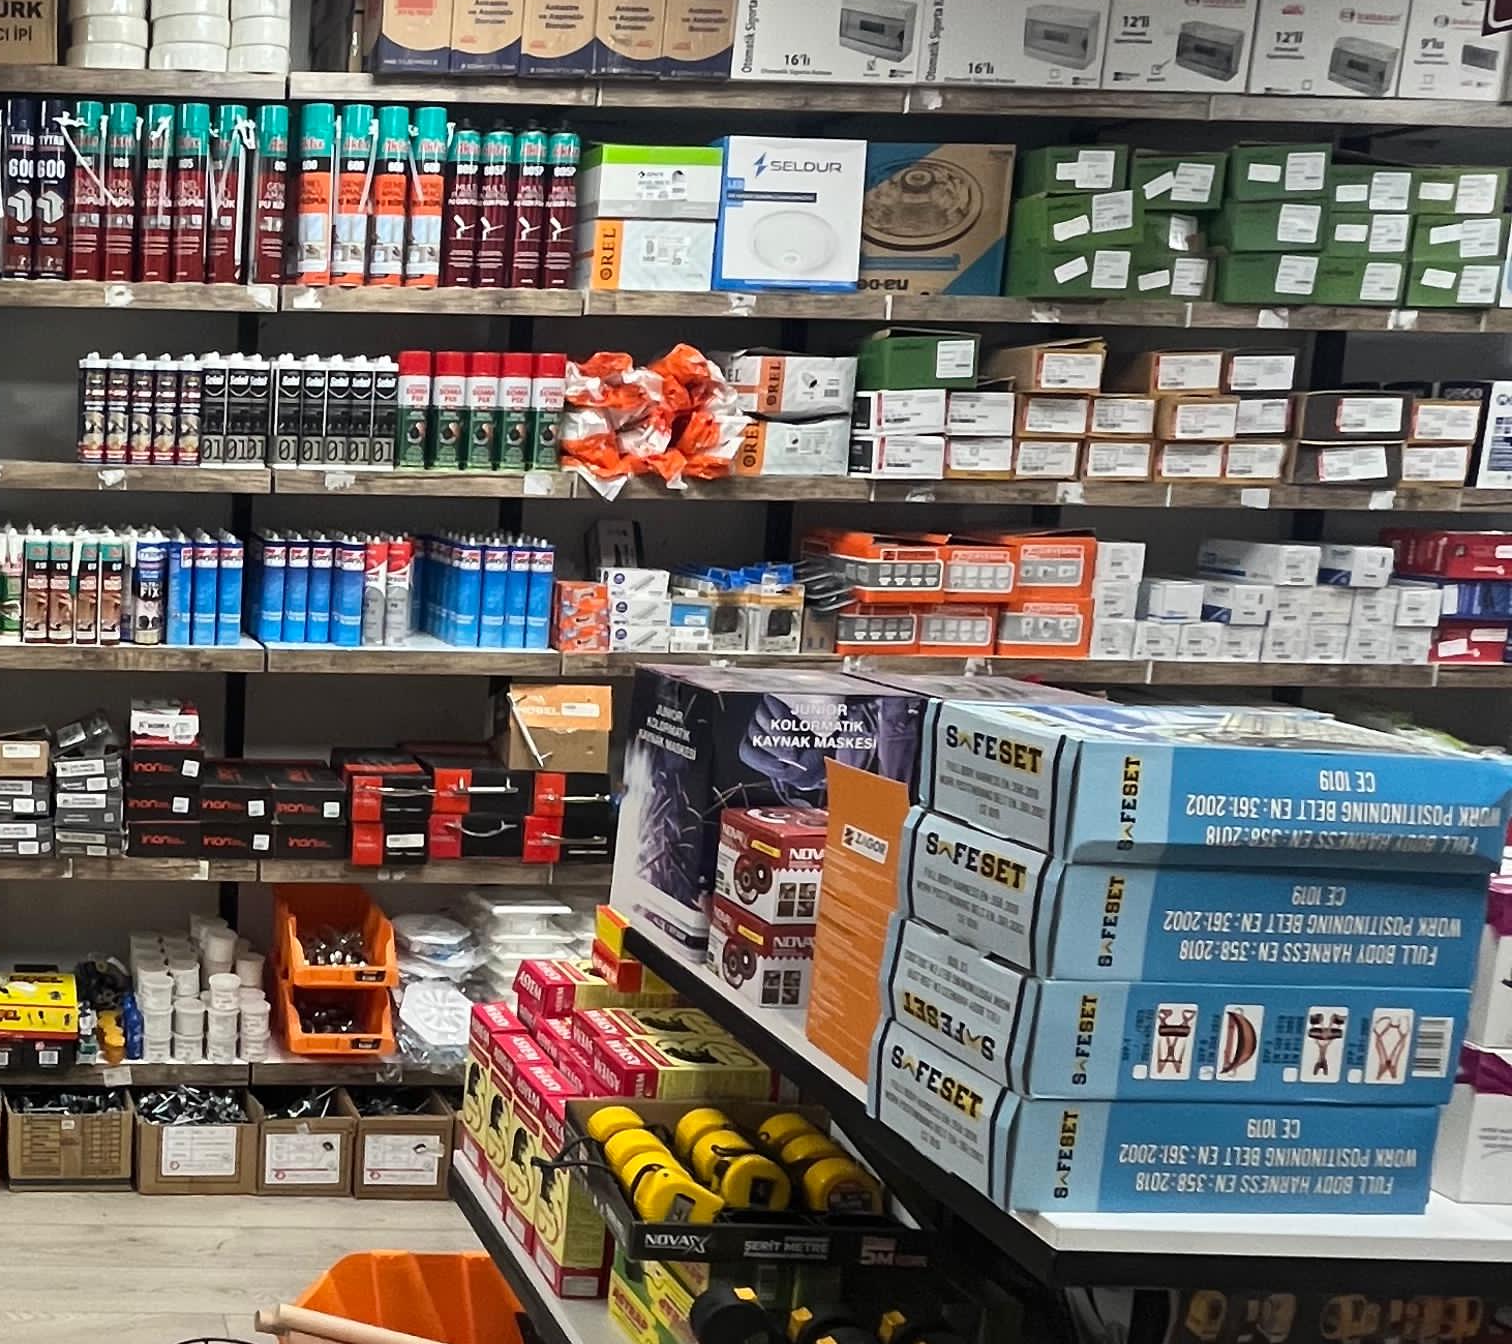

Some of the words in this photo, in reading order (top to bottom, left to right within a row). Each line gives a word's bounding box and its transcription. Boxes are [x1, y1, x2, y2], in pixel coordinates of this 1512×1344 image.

[14, 25, 32, 41] İPİ
[38, 159, 66, 179] 600
[769, 159, 843, 174] SELDUR
[791, 703, 848, 717] JUNIOR
[752, 735, 812, 749] KAYNAK
[1319, 769, 1353, 792] 1019
[1356, 770, 1376, 792] CE
[1296, 798, 1338, 824] BELT
[1291, 885, 1325, 906] 1019
[1326, 886, 1347, 906] CE
[1265, 912, 1303, 935] BELT
[1417, 915, 1463, 939] WORK
[1282, 942, 1356, 965] HARNESS
[1358, 944, 1399, 966] BODY
[1400, 946, 1439, 967] FULL
[1246, 1117, 1278, 1138] 1019
[1280, 1119, 1301, 1139] CE
[1222, 1144, 1262, 1167] BELT
[1373, 1147, 1418, 1169] WORK
[1238, 1172, 1311, 1194] HARNESS
[1313, 1173, 1354, 1196] BODY
[1355, 1174, 1394, 1196] FULL
[644, 1232, 710, 1254] NOVAX
